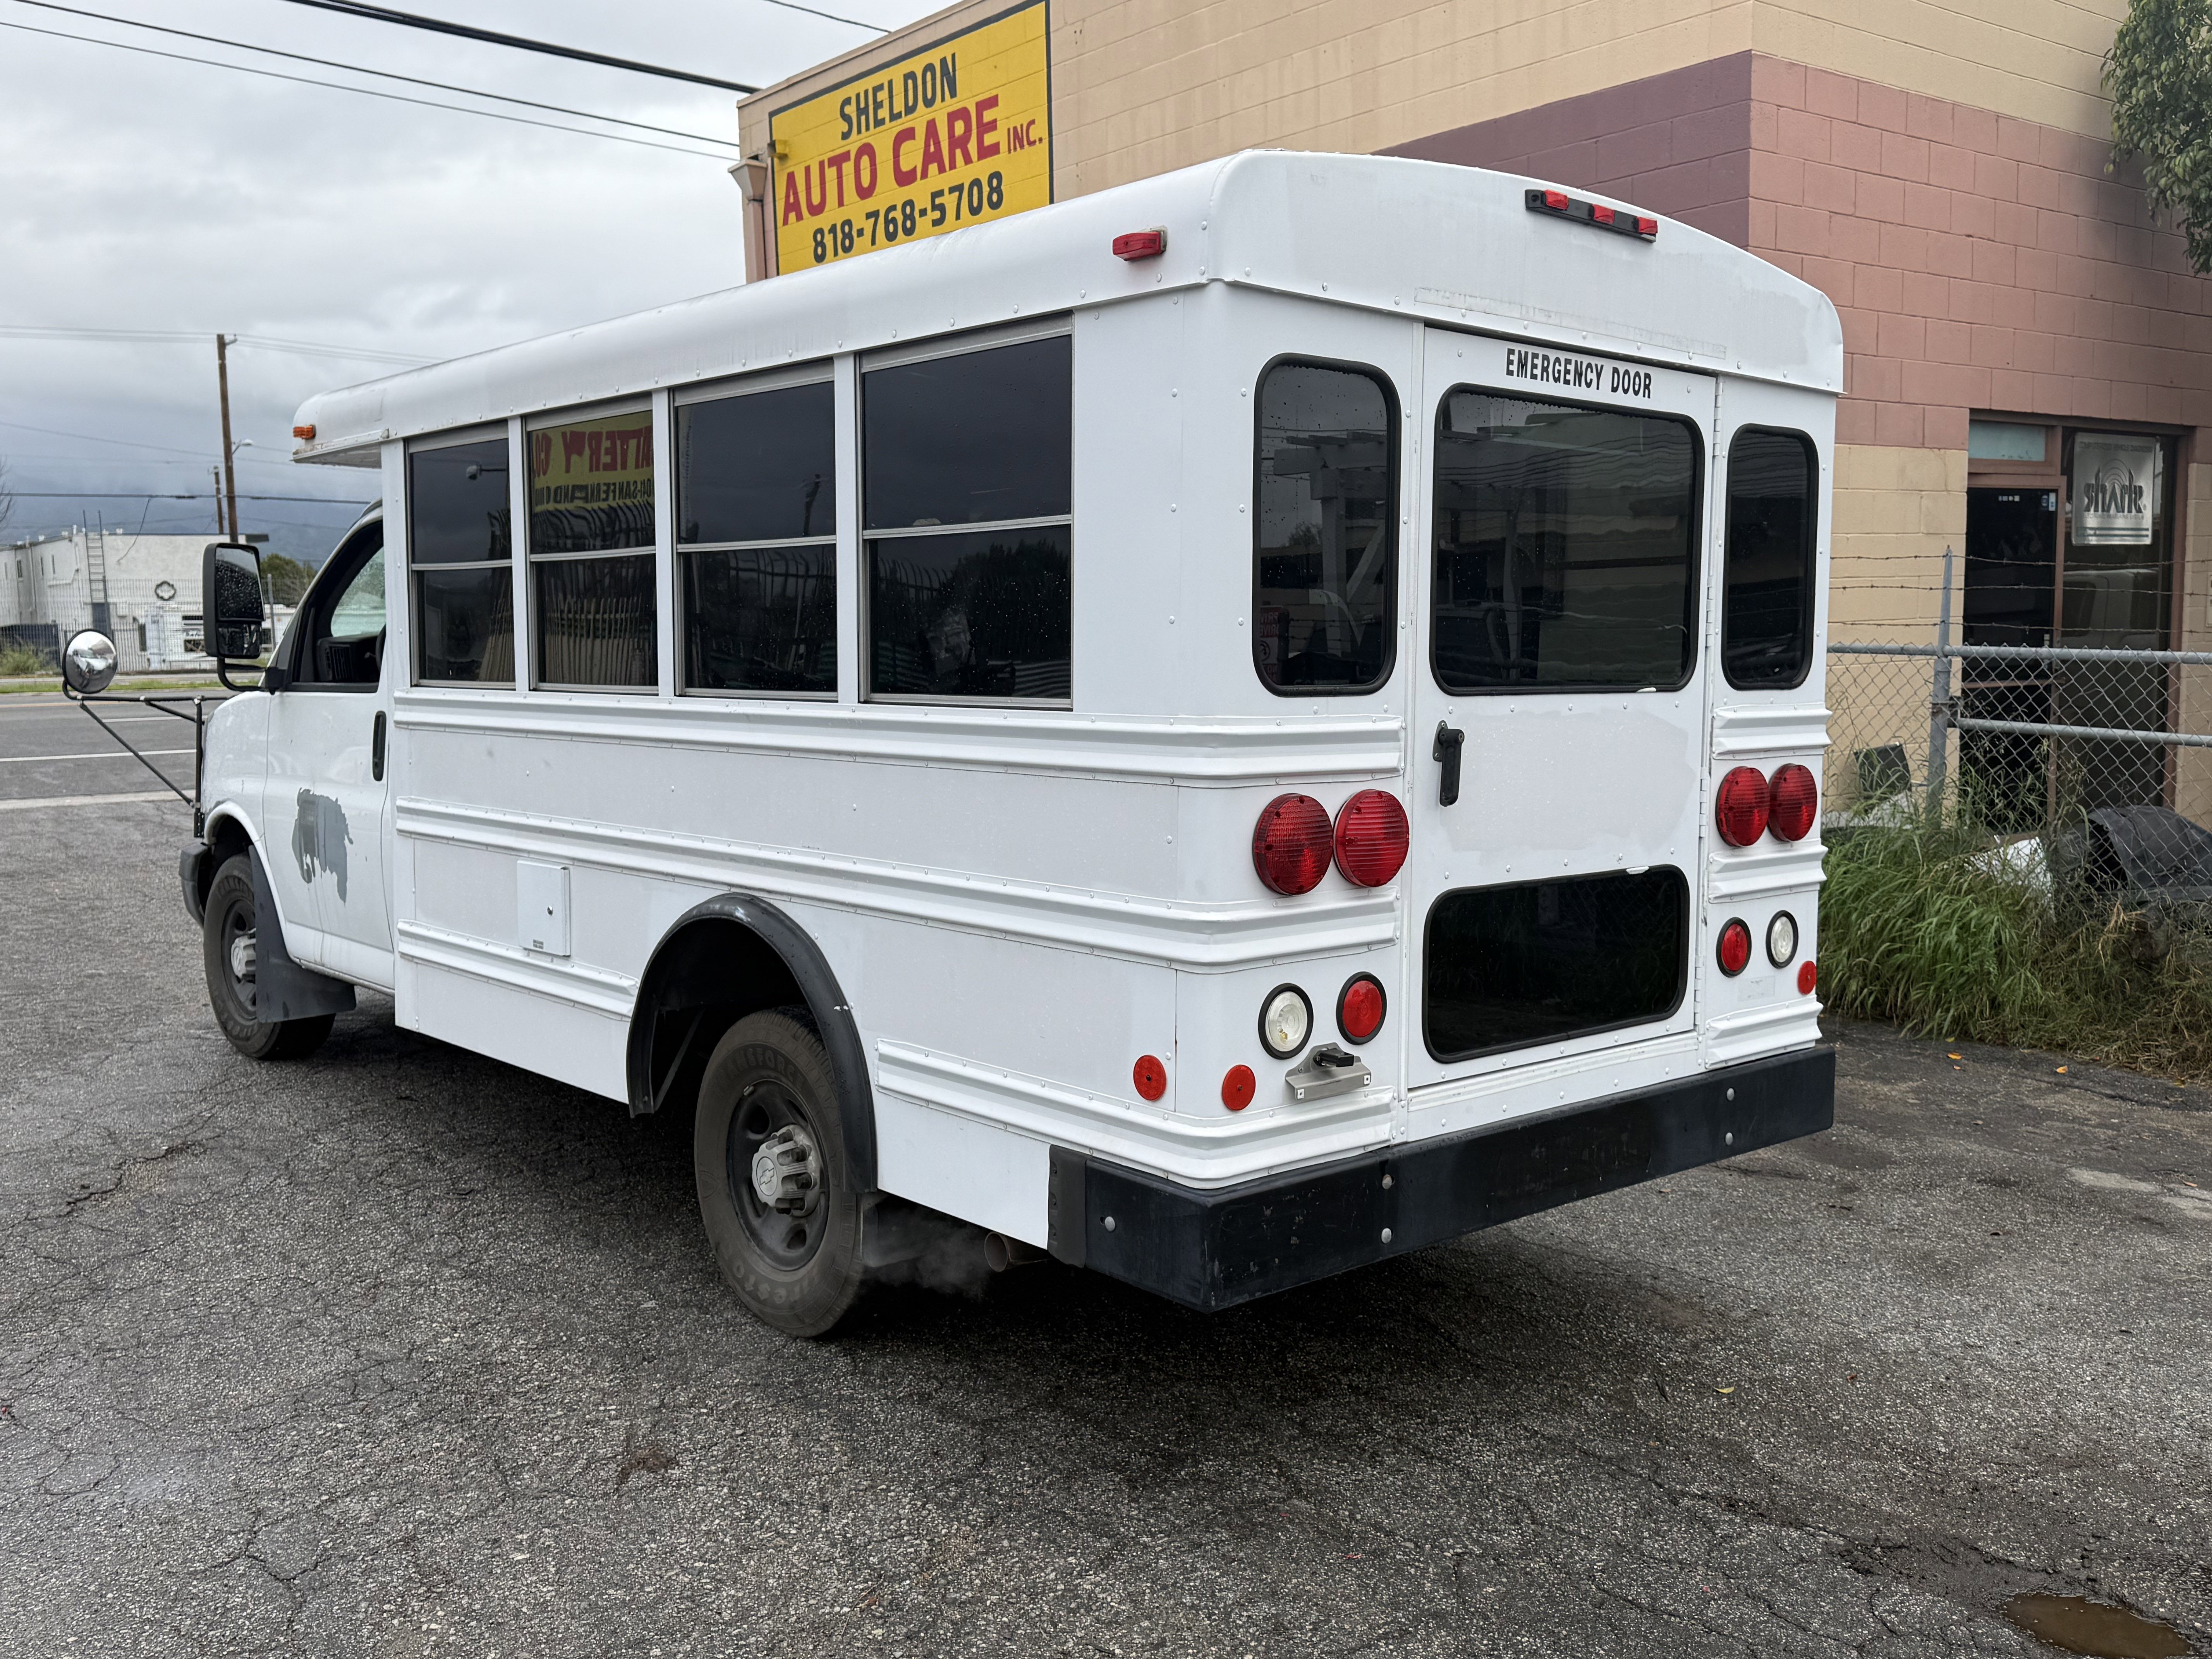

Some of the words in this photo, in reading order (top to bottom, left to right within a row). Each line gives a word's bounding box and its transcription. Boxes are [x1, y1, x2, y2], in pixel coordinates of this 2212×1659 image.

[840, 53, 957, 141] SHELDON
[783, 142, 878, 226] AUTO
[892, 94, 1001, 187] CARE
[1007, 118, 1043, 154] INC.
[813, 171, 1004, 263] 818-768-5708
[1506, 348, 1604, 390] EMERGENCY
[1611, 366, 1652, 399] DOOR
